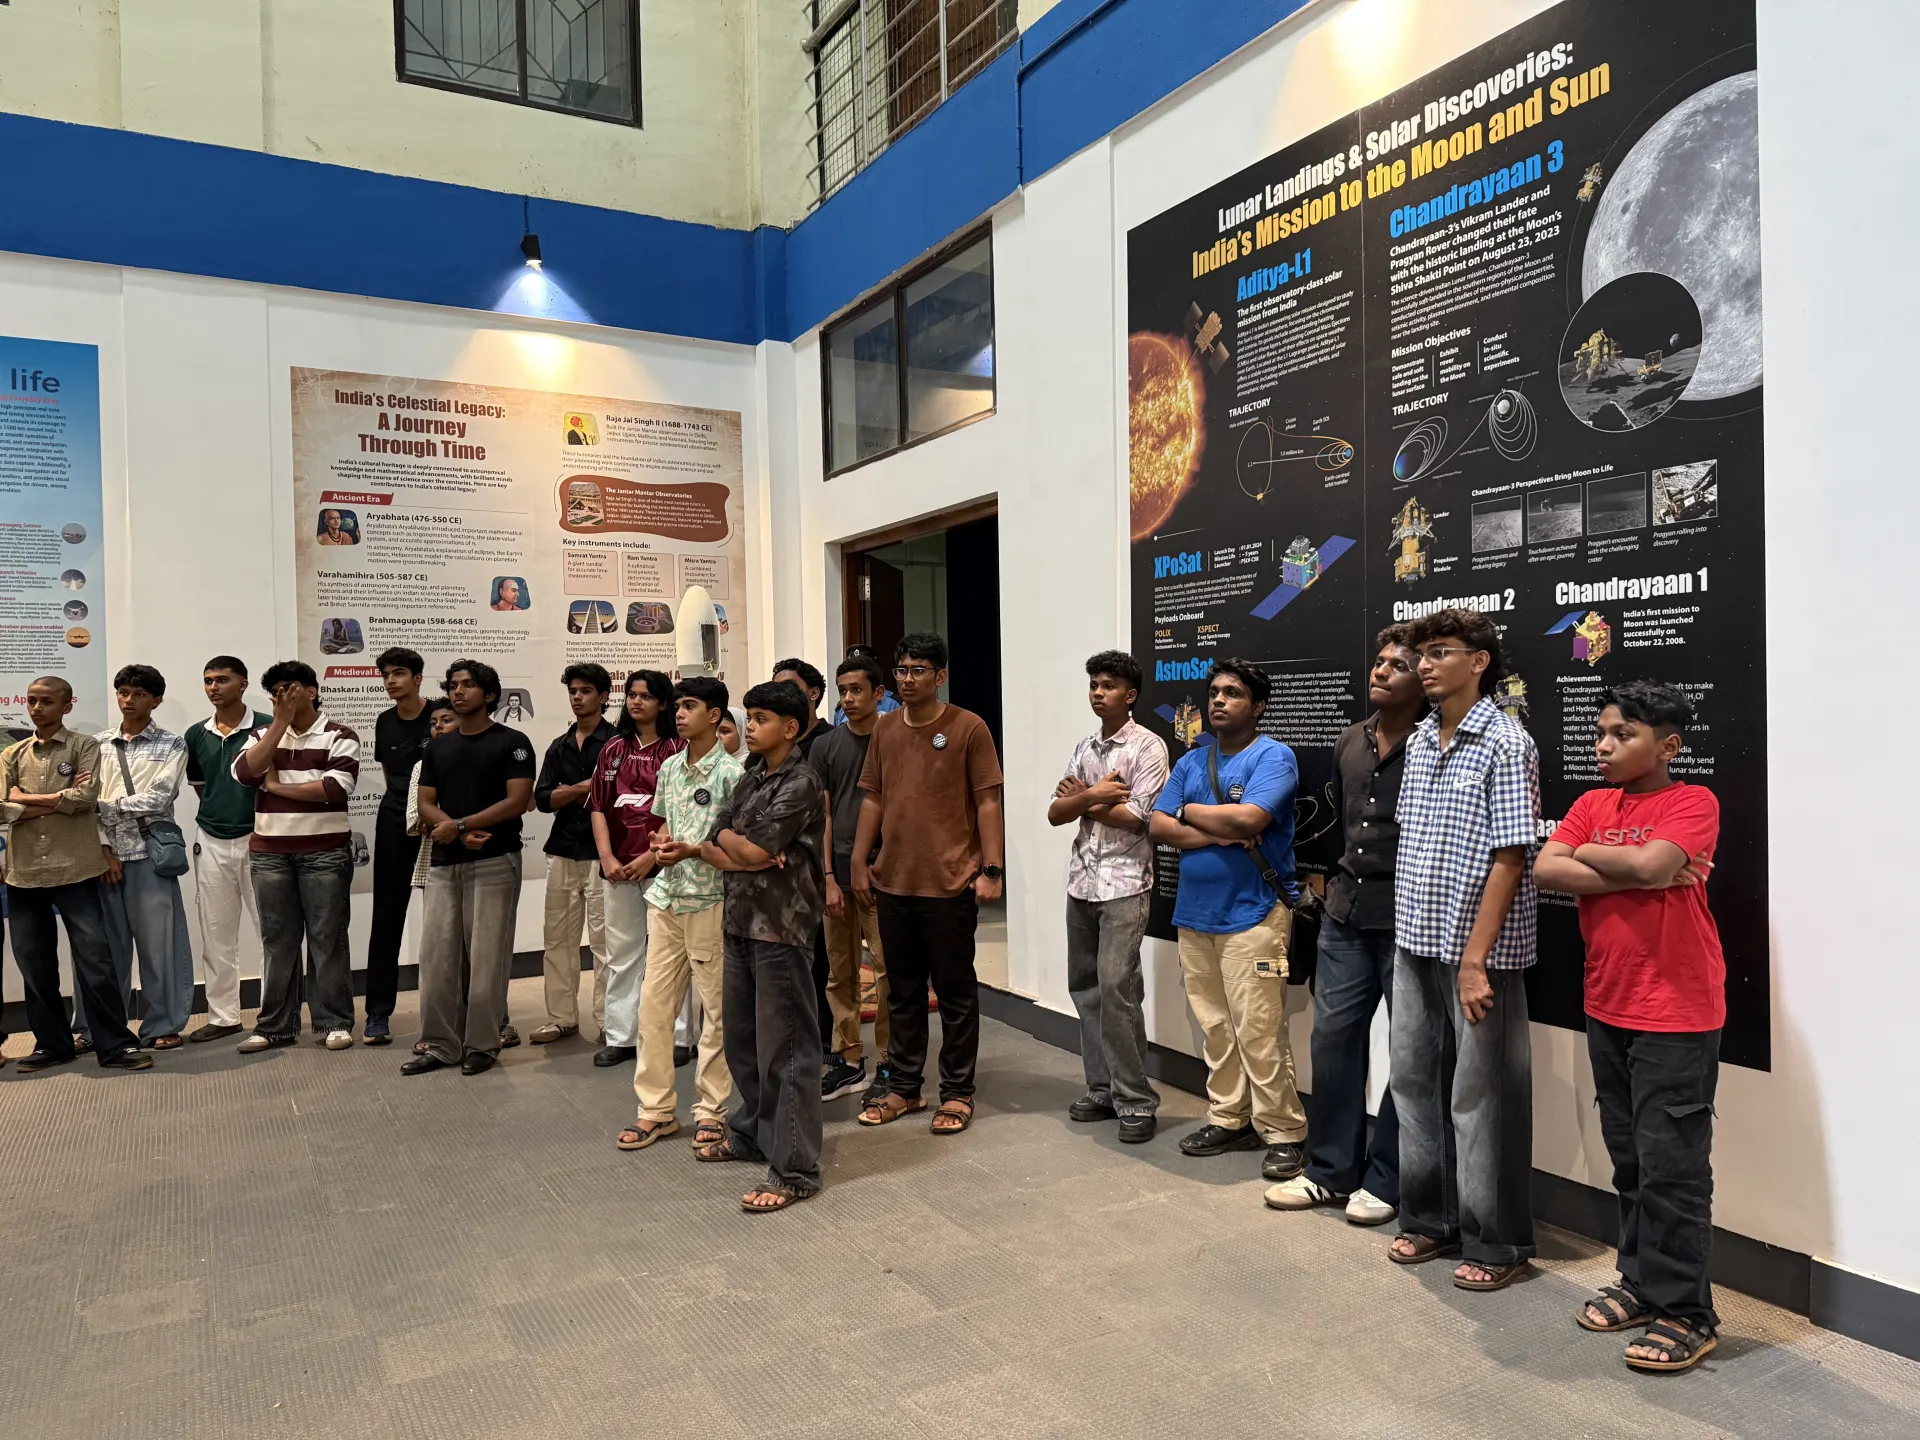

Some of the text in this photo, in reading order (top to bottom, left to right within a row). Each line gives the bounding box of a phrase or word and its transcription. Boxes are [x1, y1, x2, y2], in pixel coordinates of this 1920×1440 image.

[1219, 42, 1573, 232] Lunar Landings & Solar Discoveries:
[1192, 63, 1610, 279] India's Mission to the Moon and Sun
[1390, 140, 1564, 238] Chandrayaan 3
[1390, 185, 1550, 257] Chandrayaan-3's Vikram Lander and
[1390, 207, 1537, 270] Pragyan Rover changed their fate
[1390, 211, 1562, 282] with the historic landing at the Moon's
[1390, 226, 1560, 295] Shiva Shakti Point on August 23, 2023
[1237, 248, 1311, 302] Aditya-L1
[1237, 270, 1343, 318] The first observatory-class solar
[1237, 299, 1297, 328] mission from India
[1392, 327, 1471, 358] Mission Objectives
[1484, 332, 1508, 344] Conduct
[1440, 347, 1459, 358] Exhibit
[1484, 343, 1502, 353] in-situ
[1440, 358, 1454, 366] rover
[1484, 350, 1509, 362] scientific
[1392, 358, 1424, 372] Demonstrate
[1440, 363, 1462, 377] mobility
[1484, 356, 1520, 372] experiments
[11, 368, 60, 393] life
[1392, 366, 1423, 381] safe and soft
[1450, 372, 1465, 381] Moon
[1392, 378, 1411, 389] landing
[1392, 383, 1425, 397] lunar surface
[335, 389, 506, 418] India's Celestial Legacy:
[1229, 397, 1271, 417] TRAJECTORY
[1392, 392, 1449, 416] TRAJECTORY
[378, 413, 466, 438] A Journey
[606, 415, 621, 423] Raja
[623, 416, 632, 424] Jai
[634, 417, 654, 426] Singh
[662, 420, 699, 430] (1688-1743
[702, 424, 712, 432] CE)
[358, 434, 486, 460] Through Time
[382, 461, 406, 469] heritage
[1472, 483, 1515, 496] Chandrayaan-3
[1516, 476, 1553, 488] Perspectives
[1554, 473, 1571, 481] Bring
[1573, 470, 1591, 478] Moon
[1601, 464, 1613, 472] Life
[333, 493, 365, 502] Ancient
[367, 513, 462, 524] Aryabhata (476-550 CE)
[578, 539, 621, 547] instruments
[1653, 539, 1679, 547] discovery
[1154, 551, 1201, 579] XPoSat
[317, 571, 374, 579] Varahamihira
[1556, 567, 1707, 605] Chandrayaan 1
[1504, 588, 1515, 610] 2
[1155, 611, 1204, 624] Payloads Onboard
[1624, 609, 1646, 618] India's
[1662, 607, 1690, 615] mission
[369, 617, 425, 625] Brahmagupta
[1624, 620, 1643, 628] Moon
[1660, 616, 1693, 625] launched
[1155, 629, 1171, 637] POLIX
[1197, 624, 1219, 633] XSPECT
[1624, 628, 1665, 638] successfully
[1624, 639, 1651, 648] October
[1563, 714, 1586, 722] surface.
[1563, 745, 1585, 753] During
[1573, 773, 1605, 781] November
[1688, 766, 1714, 774] surface
